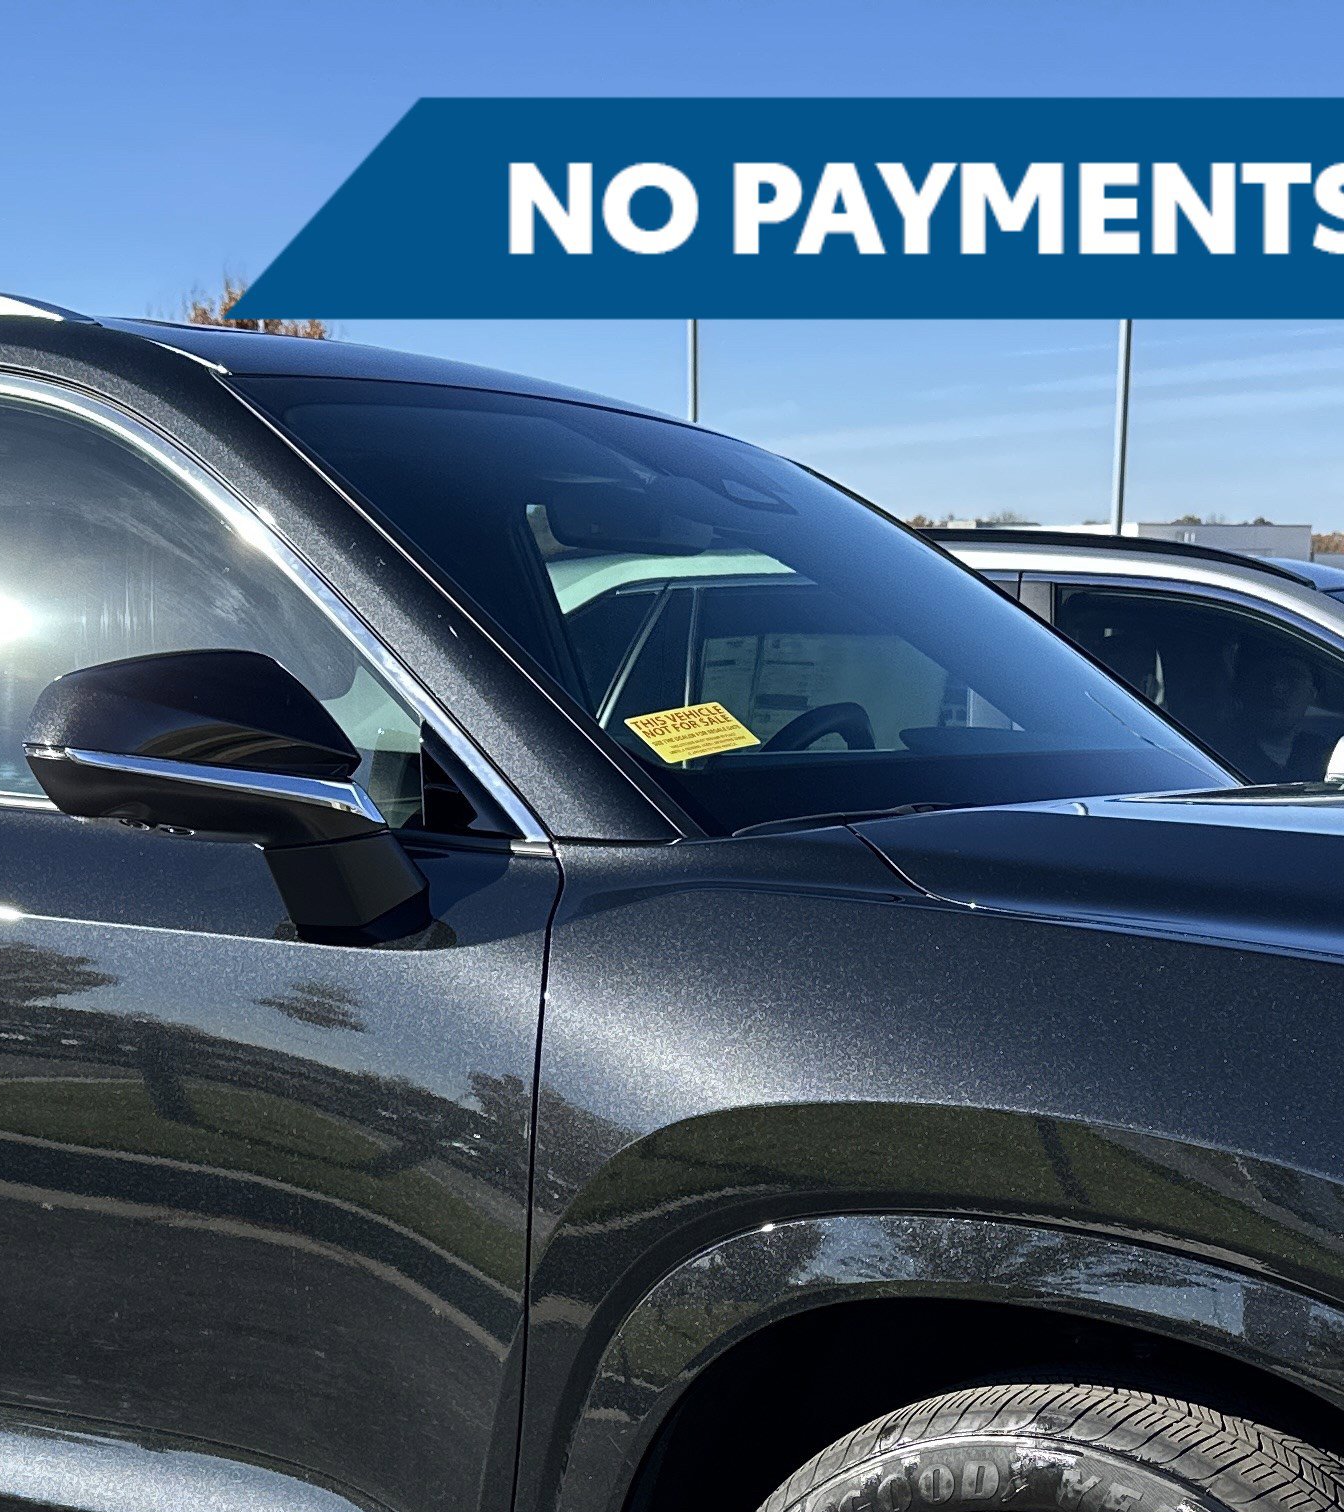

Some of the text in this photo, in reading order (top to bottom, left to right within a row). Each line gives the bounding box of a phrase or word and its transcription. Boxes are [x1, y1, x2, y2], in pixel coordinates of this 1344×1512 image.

[630, 705, 725, 731] THIS VEHICLE
[641, 725, 674, 739] NOT
[672, 719, 699, 733] FOR
[699, 714, 733, 729] SALE
